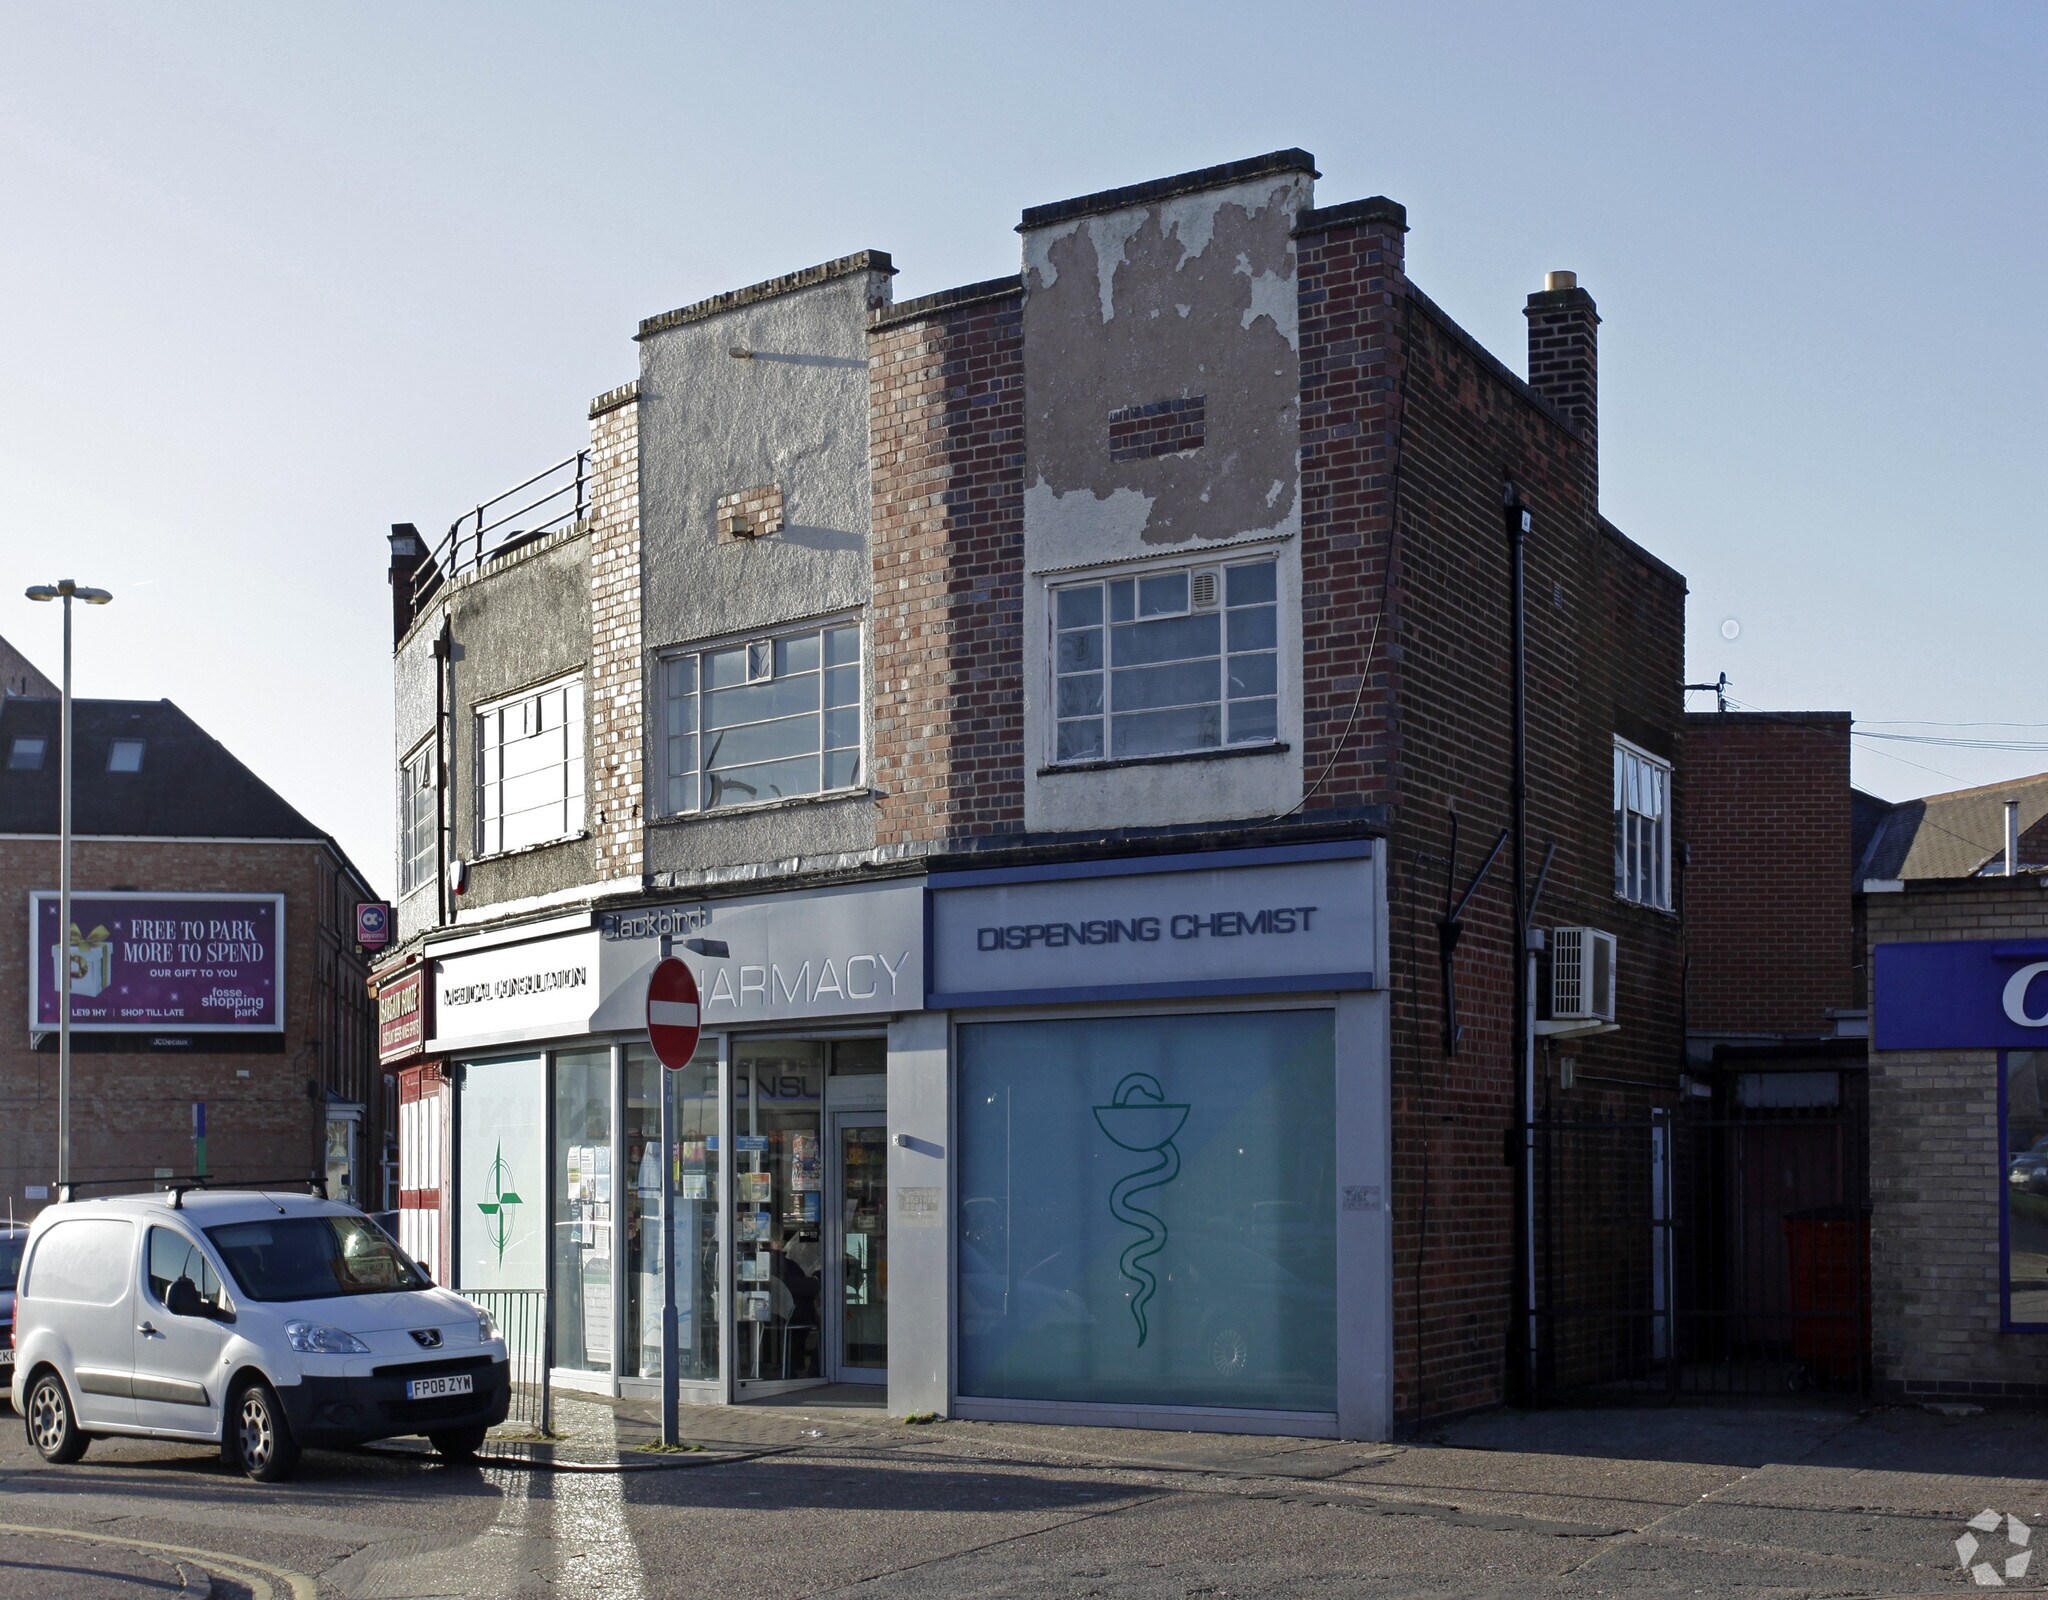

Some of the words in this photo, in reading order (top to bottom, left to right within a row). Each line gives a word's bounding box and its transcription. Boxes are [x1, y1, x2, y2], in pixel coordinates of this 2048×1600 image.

[131, 919, 176, 941] FREE
[181, 920, 204, 940] TO
[209, 919, 256, 941] PARK
[600, 905, 705, 939] Blackbird
[977, 917, 1160, 951] DISPENSING
[1170, 906, 1318, 940] CHEMIST
[123, 942, 173, 963] MORE
[178, 942, 201, 963] TO
[206, 941, 264, 964] SPEND
[150, 969, 171, 978] OUR
[174, 969, 197, 978] GIFT
[200, 969, 214, 978] TO
[216, 969, 238, 978] YOU
[697, 951, 909, 1010] ARMACY
[212, 986, 242, 998] fosse
[443, 982, 493, 1007] MEDICAL
[494, 966, 587, 999] CONSULTATION
[201, 994, 264, 1010] shopping
[72, 1008, 91, 1017] LE19
[92, 1008, 107, 1017] 1HY
[121, 1008, 144, 1017] SHOP
[145, 1008, 162, 1017] TILL
[164, 1008, 184, 1017] LATE
[234, 1007, 259, 1018] park
[153, 1038, 188, 1046] JCDecaux
[414, 1379, 446, 1396] FP08
